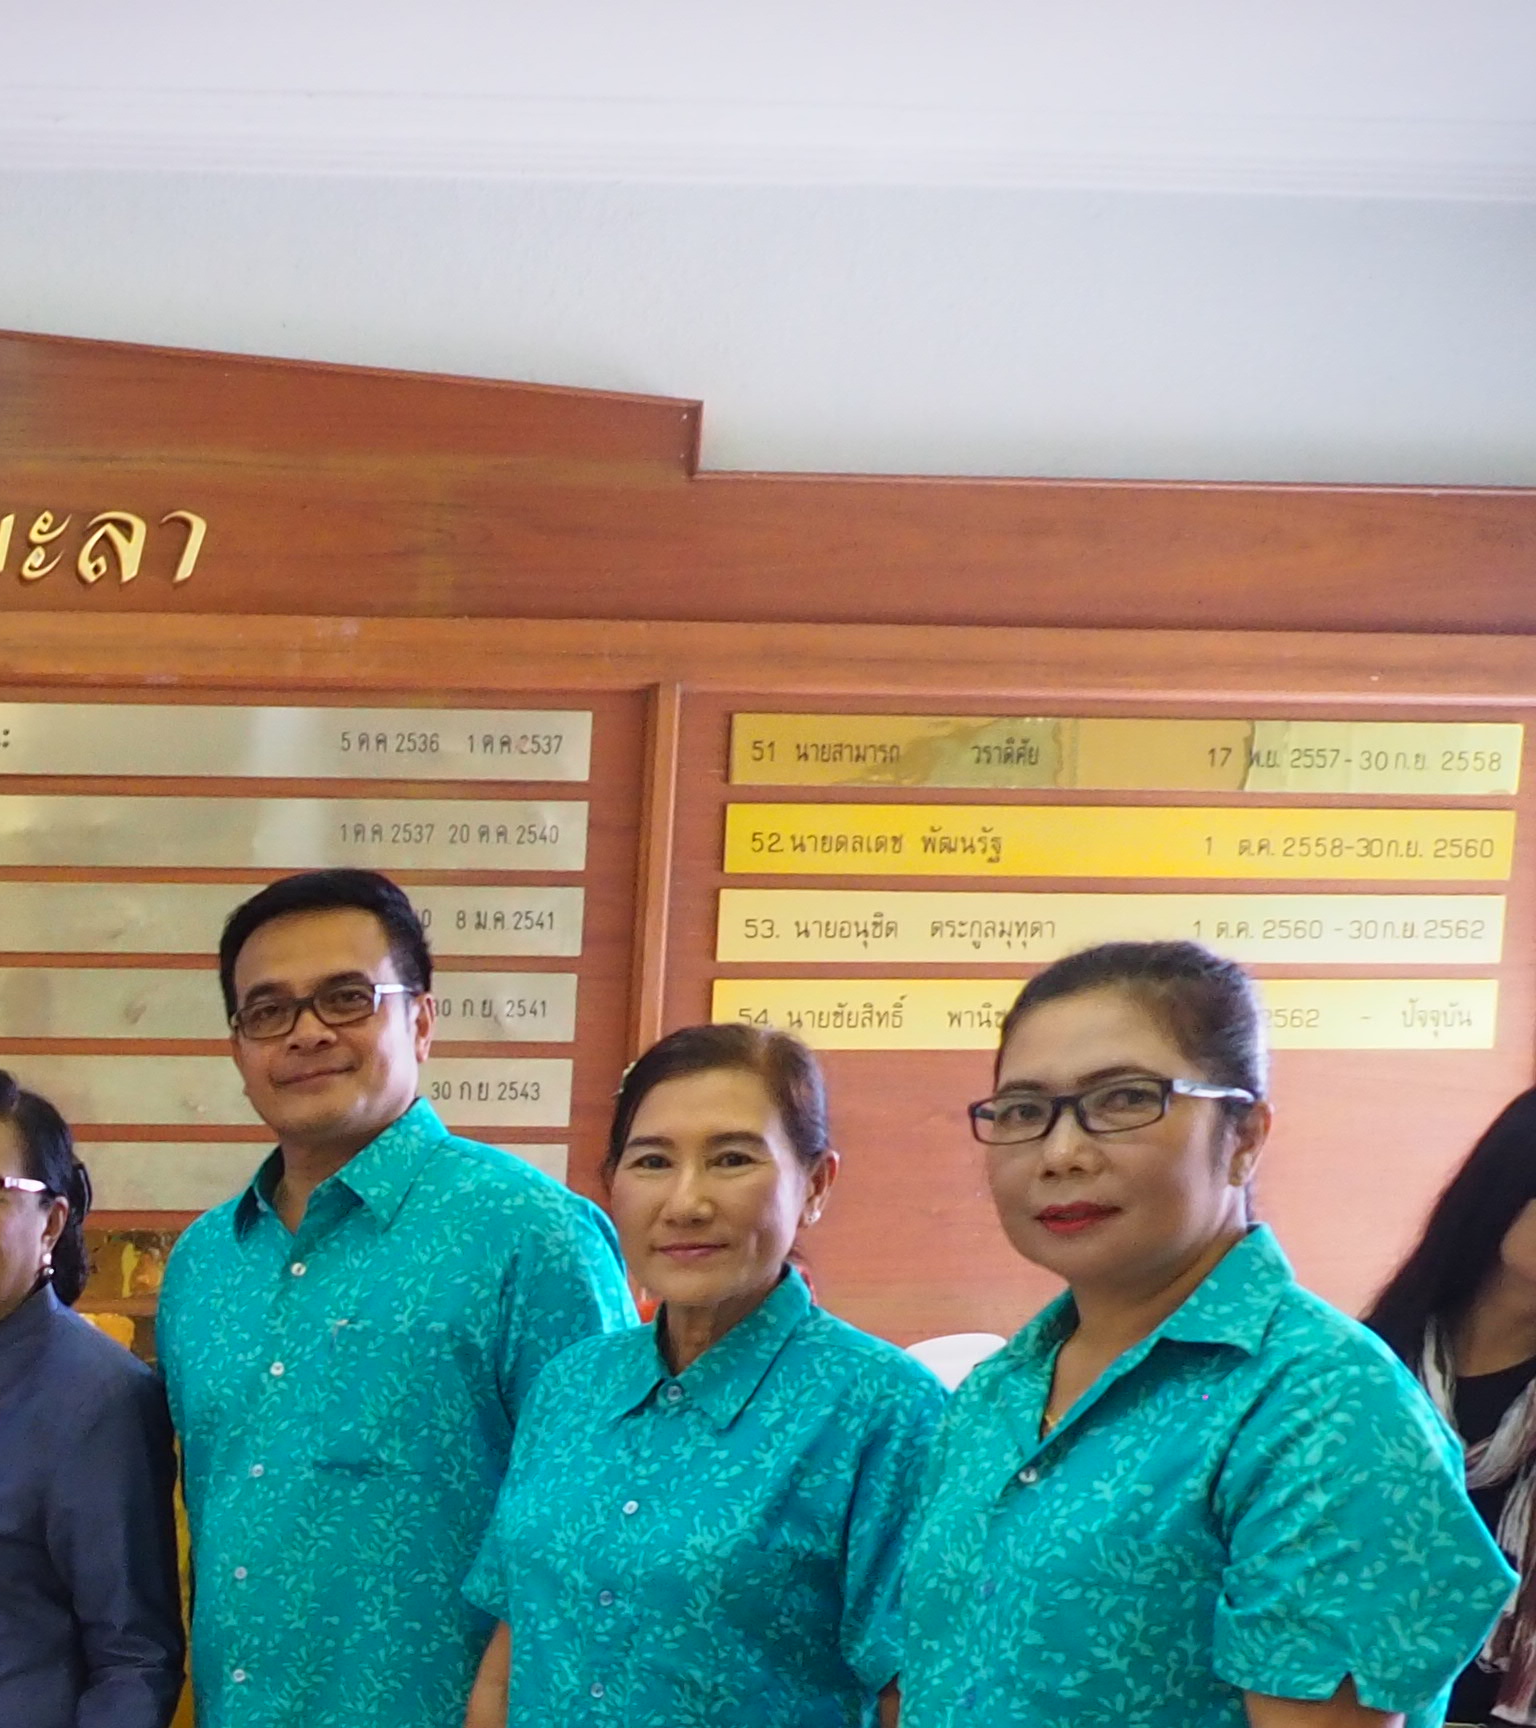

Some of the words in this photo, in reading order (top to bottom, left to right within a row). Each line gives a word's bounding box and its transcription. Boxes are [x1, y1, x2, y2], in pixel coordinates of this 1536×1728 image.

[1207, 747, 1233, 768] 17
[1440, 750, 1503, 772] 2558
[1433, 837, 1495, 859] 2560
[1401, 996, 1473, 1040] ปัจจุบัน
